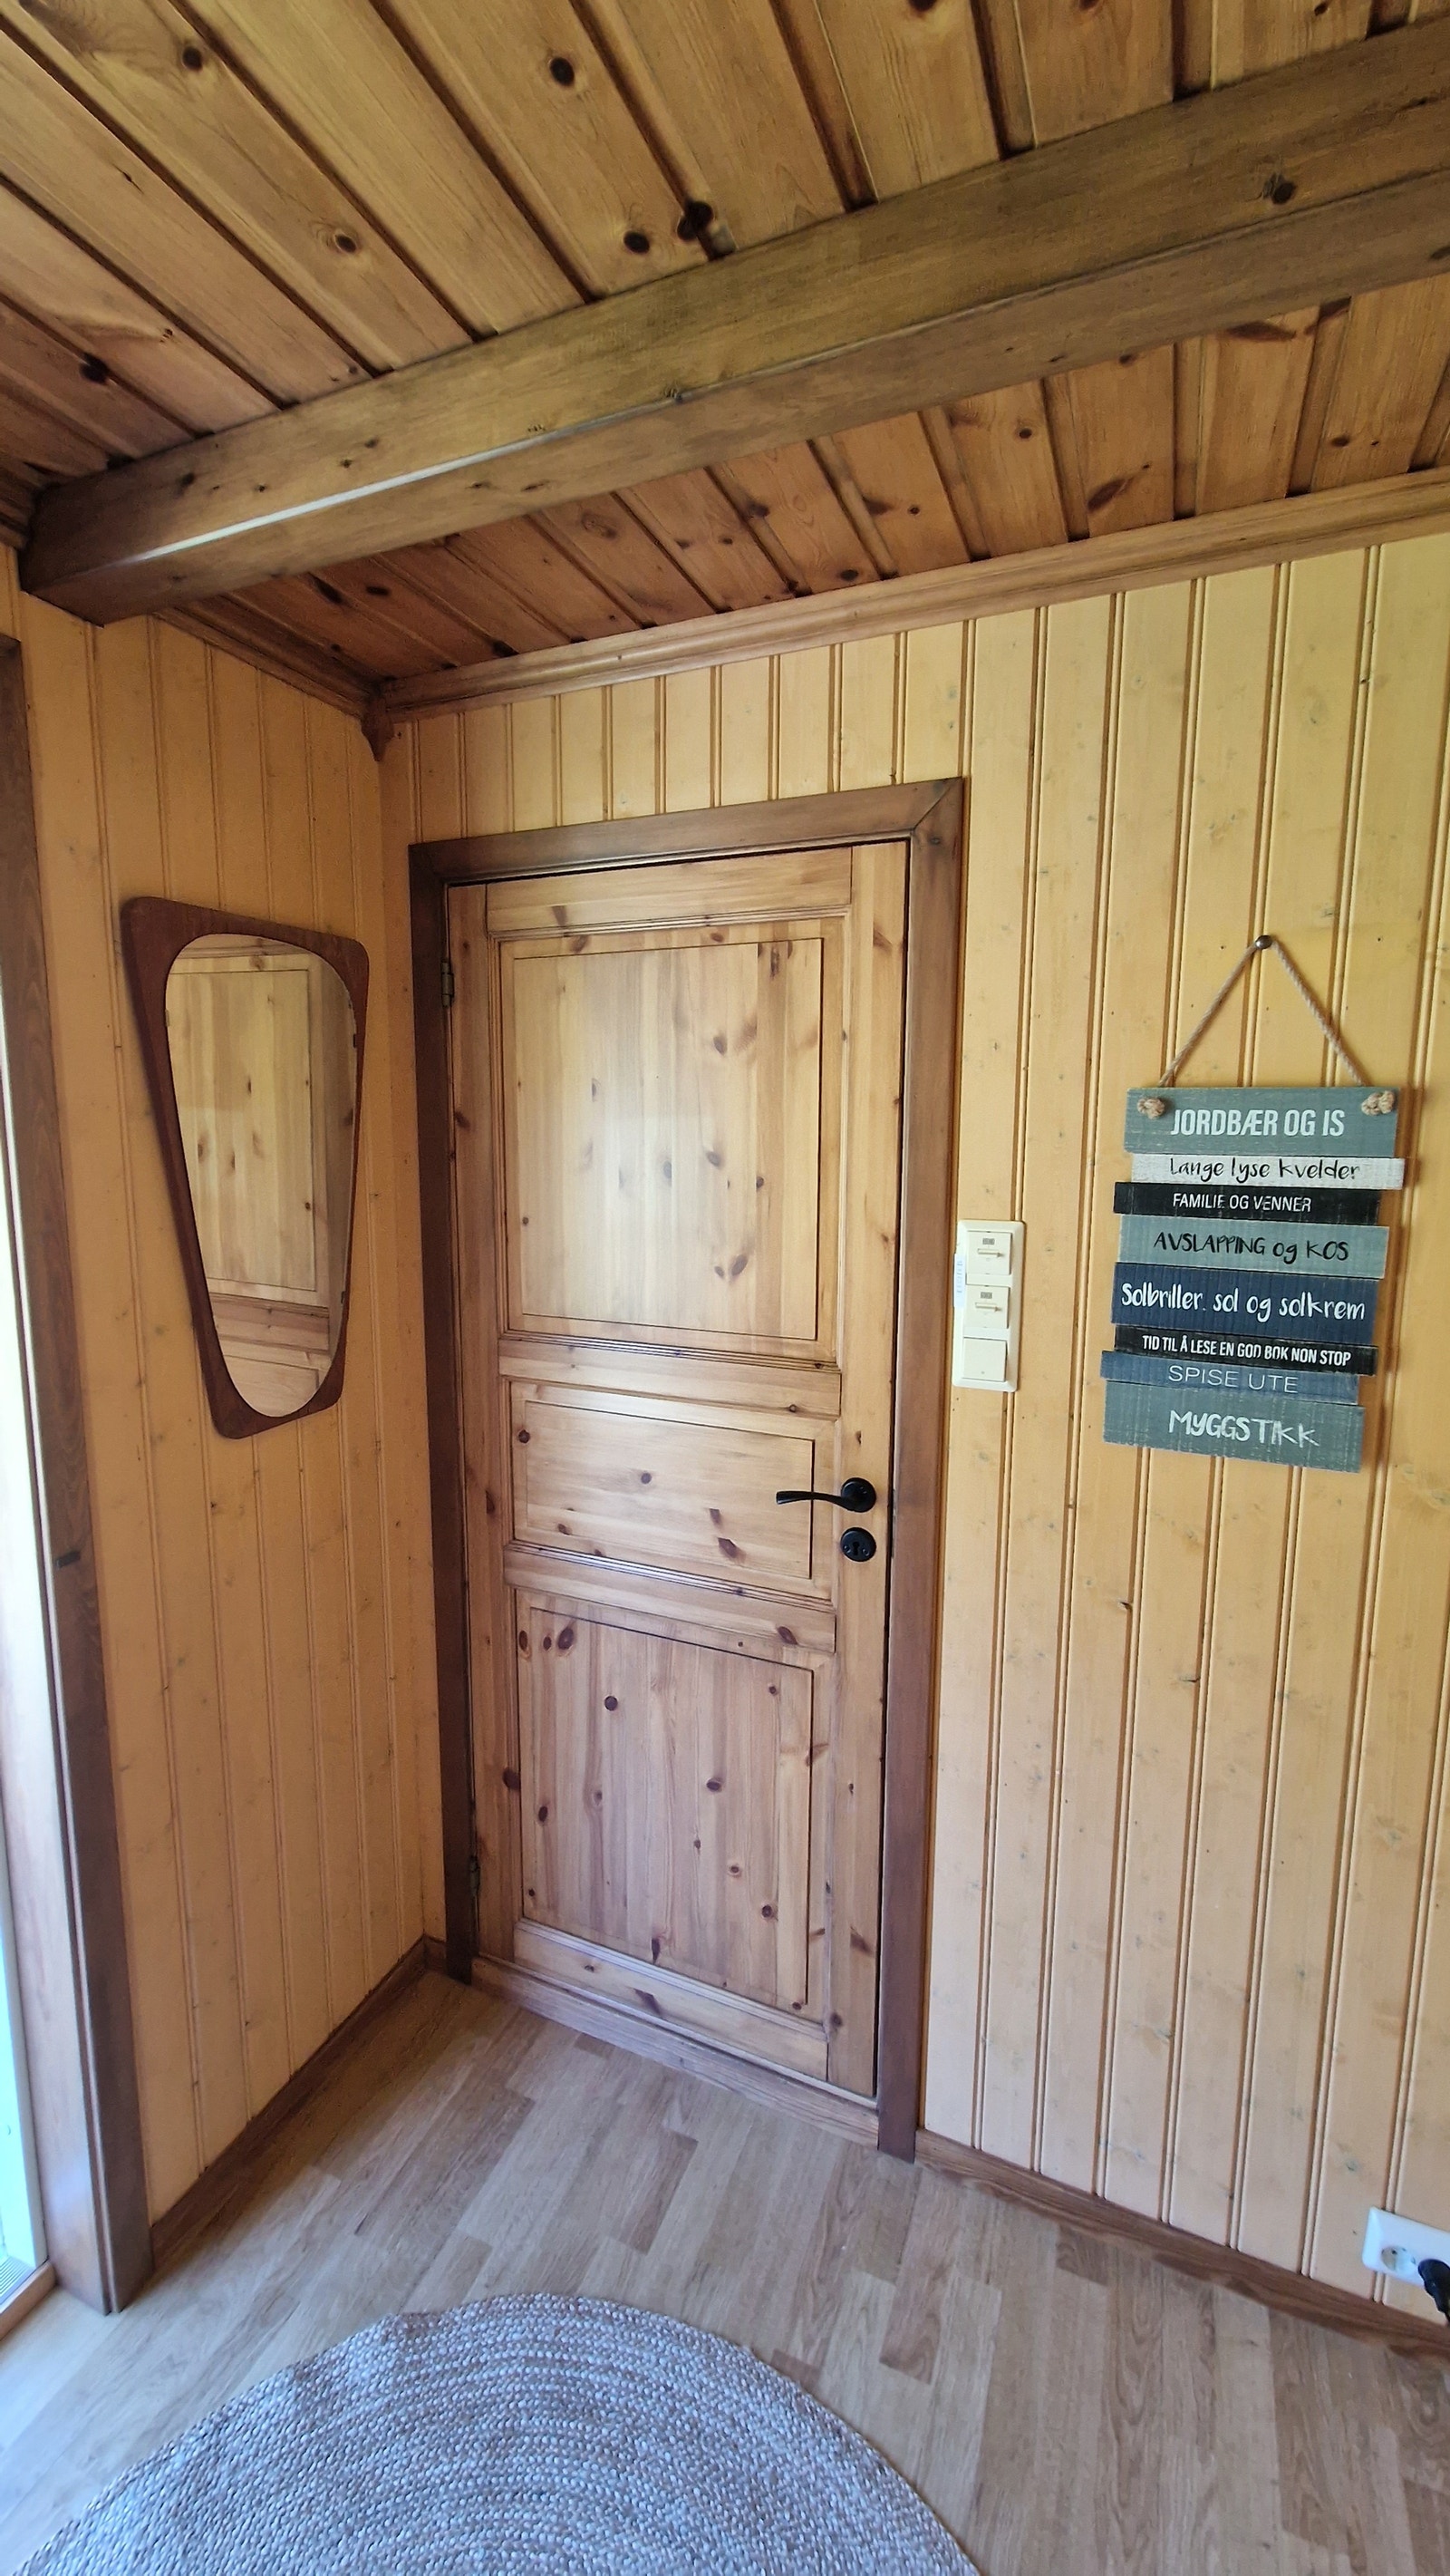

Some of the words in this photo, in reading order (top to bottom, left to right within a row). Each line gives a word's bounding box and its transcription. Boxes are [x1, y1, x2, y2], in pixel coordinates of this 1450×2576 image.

[1171, 1109, 1278, 1136] JORDBÆR
[1284, 1109, 1315, 1136] OG
[1322, 1110, 1345, 1136] IS
[1173, 1193, 1225, 1209] FAMILIE
[1230, 1195, 1249, 1209] OG
[1254, 1196, 1311, 1212] VENNER
[1154, 1231, 1265, 1255] AVSLAPPING
[1272, 1243, 1299, 1264] og
[1213, 1288, 1239, 1313] sol
[1247, 1294, 1271, 1322] og
[1279, 1292, 1365, 1321] solkrem
[1143, 1335, 1159, 1350] TID
[1163, 1336, 1177, 1351] TIL
[1179, 1335, 1188, 1352] Å
[1191, 1340, 1217, 1355] LESE
[1220, 1341, 1234, 1356] EN
[1237, 1343, 1262, 1359] GOD
[1264, 1346, 1288, 1361] BOK
[1291, 1348, 1316, 1363] NON
[1320, 1351, 1351, 1367] STOP
[1168, 1365, 1239, 1389] SPISE
[1248, 1373, 1299, 1393] UTE
